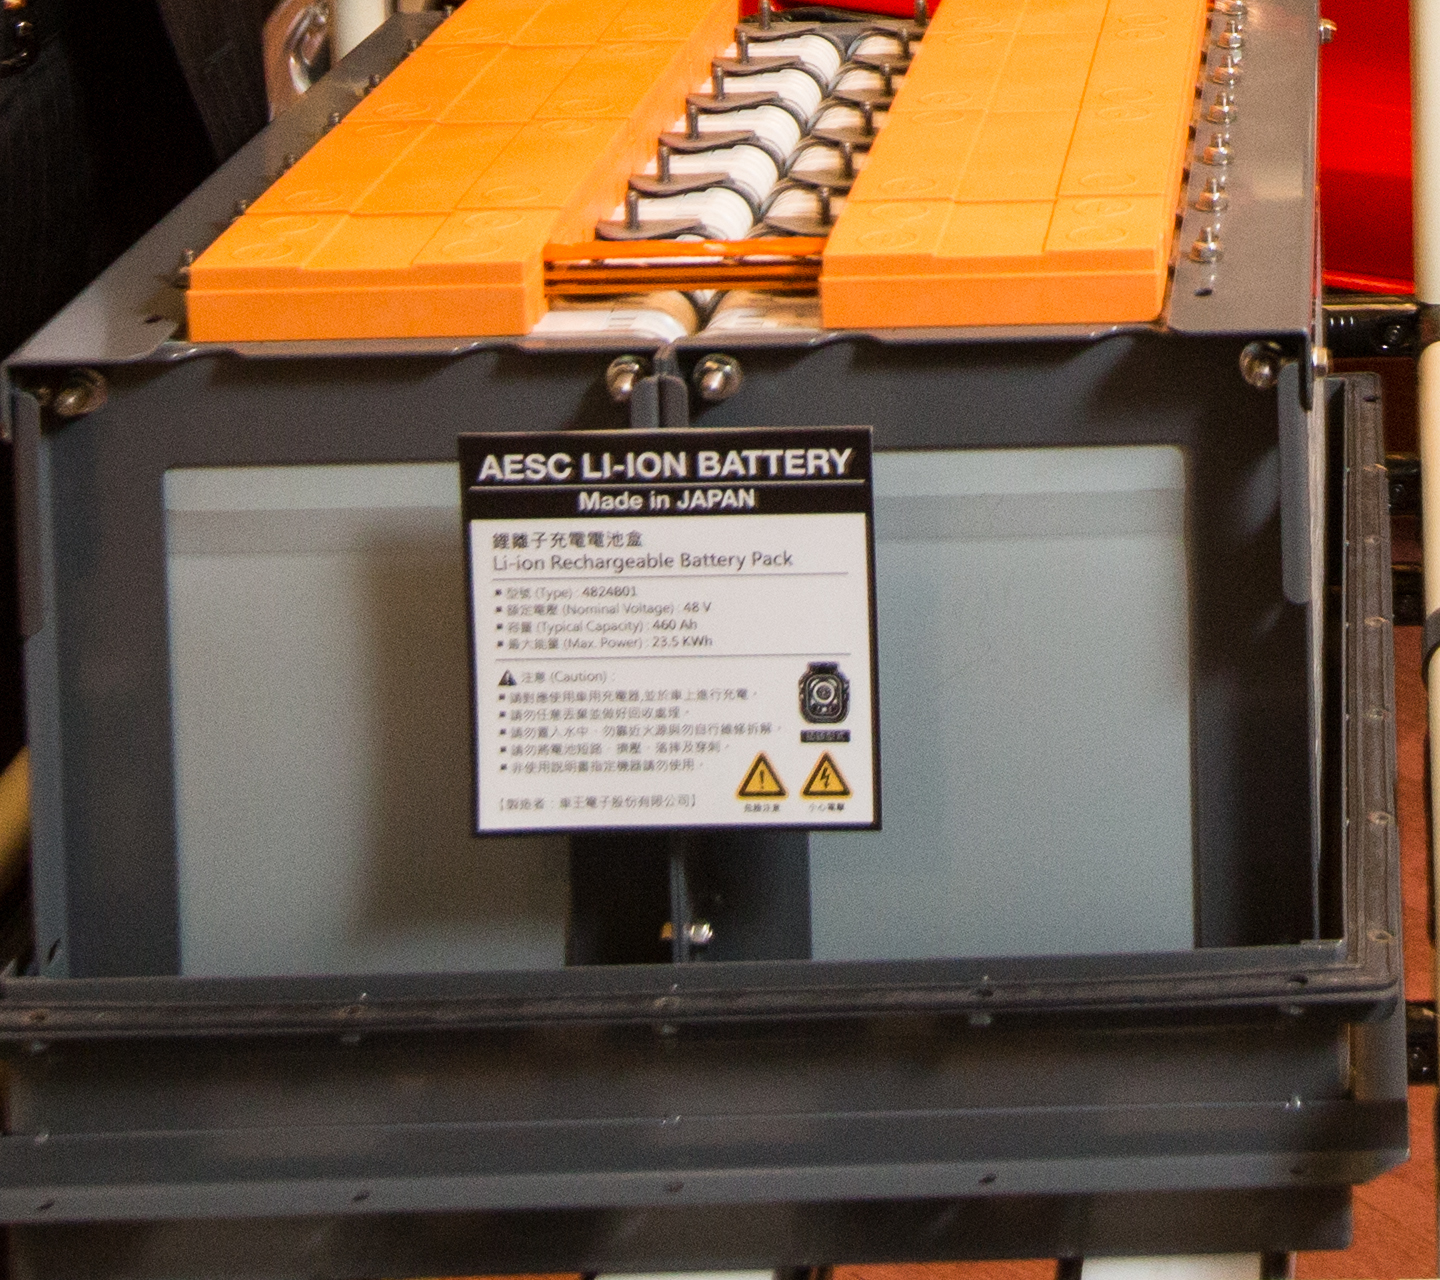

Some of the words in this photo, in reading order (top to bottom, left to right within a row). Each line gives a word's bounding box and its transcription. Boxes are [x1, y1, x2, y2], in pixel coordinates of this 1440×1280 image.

[478, 453, 572, 482] AESC
[582, 451, 687, 480] LI-ION
[697, 447, 853, 478] BATTERY
[578, 491, 643, 512] Made
[649, 490, 671, 511] in
[677, 488, 756, 509] JAPAN
[493, 555, 545, 571] Li-ion
[551, 552, 675, 573] Rechargeable
[680, 552, 746, 571] Battery
[752, 550, 793, 567] Pack
[562, 604, 620, 616] (Nominal
[684, 602, 699, 613] 48
[536, 620, 583, 635] (Typical
[652, 619, 677, 630] 460
[680, 618, 698, 630] Ah
[683, 636, 713, 647] KWh
